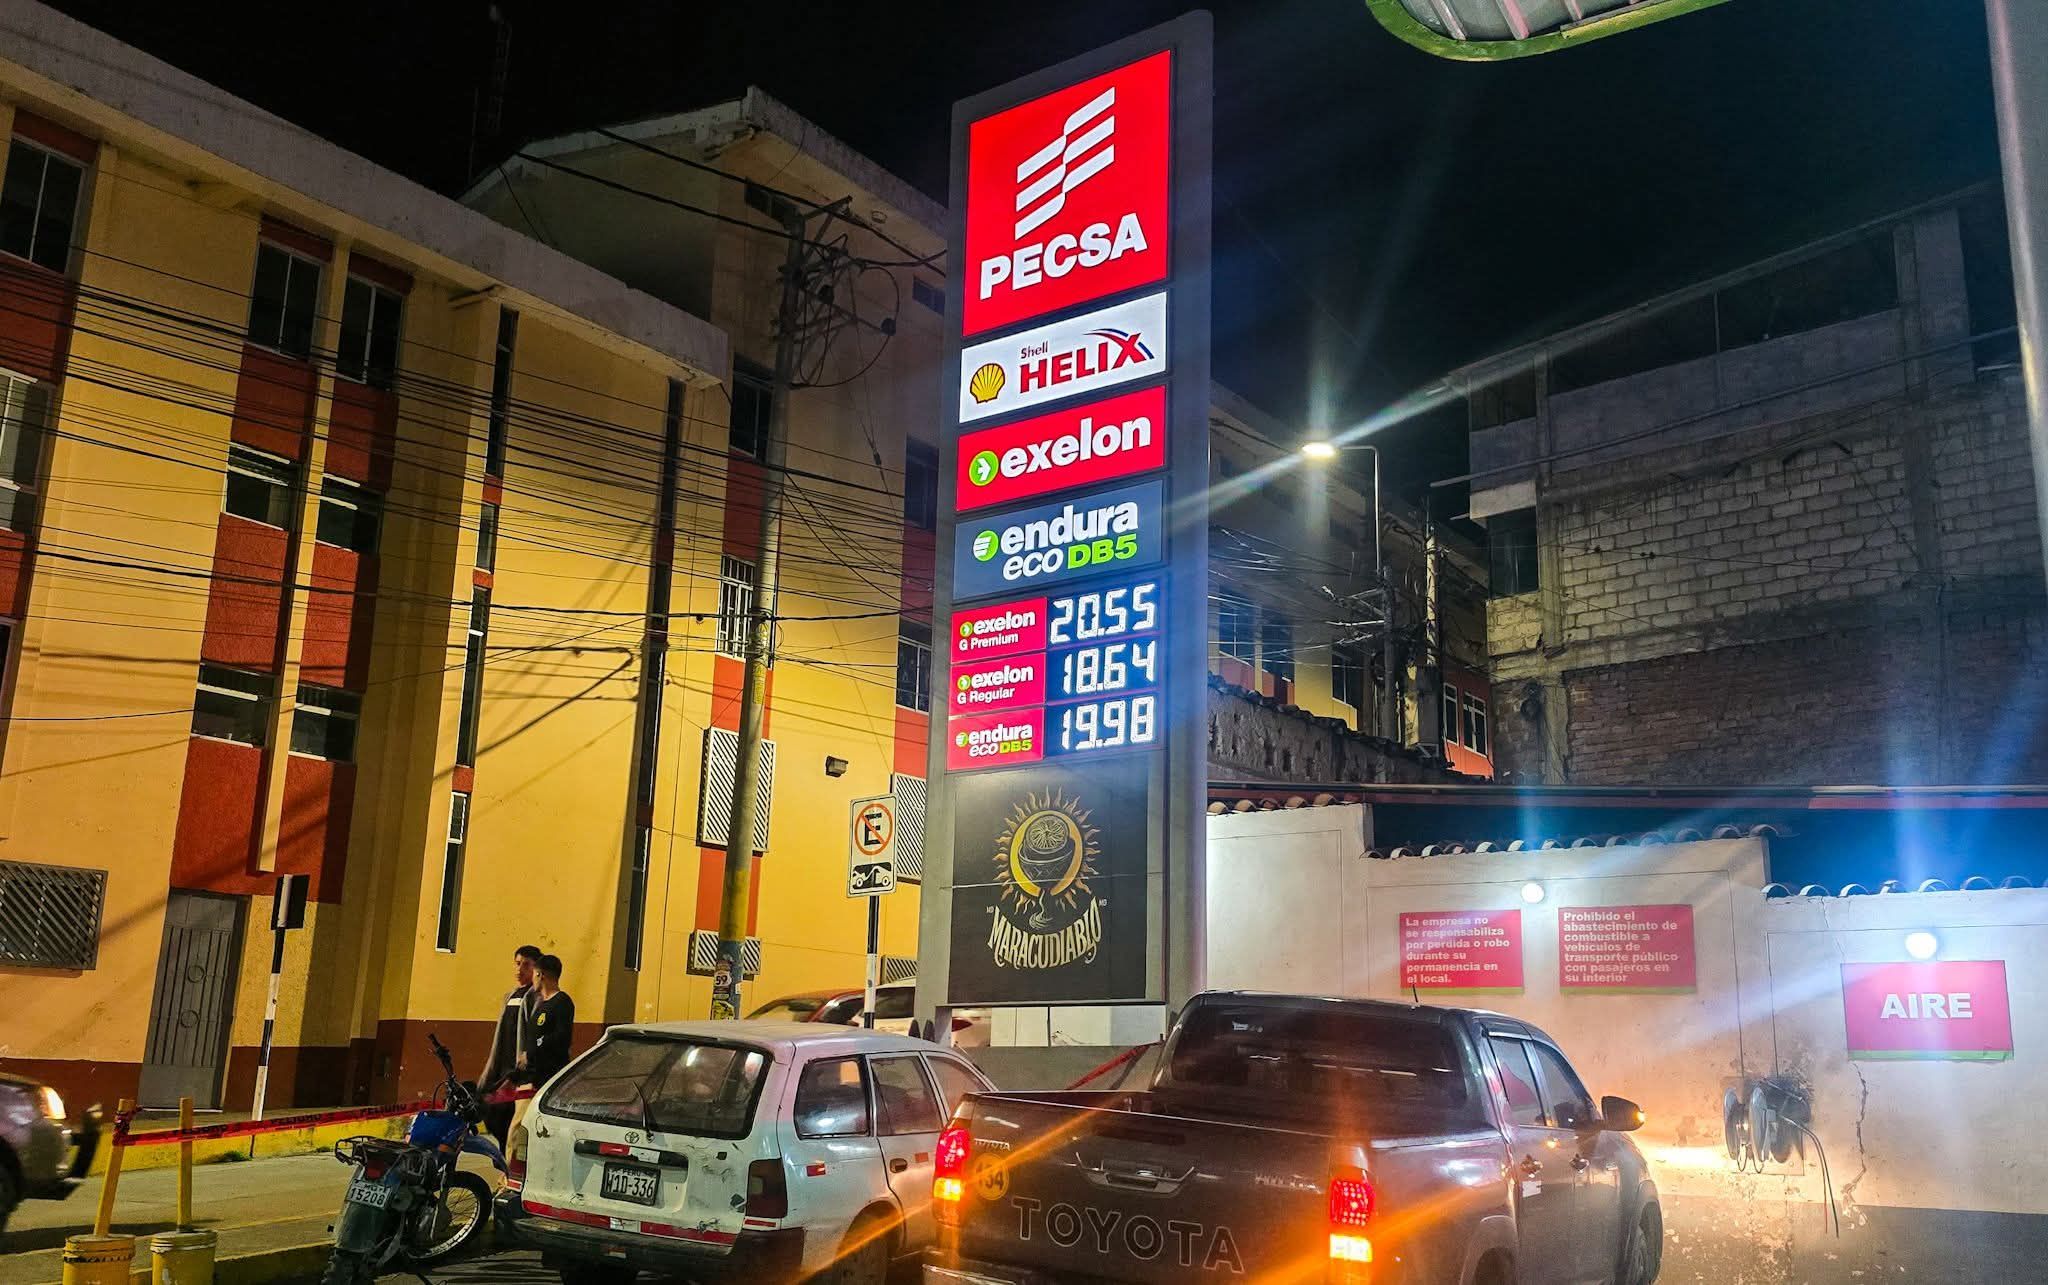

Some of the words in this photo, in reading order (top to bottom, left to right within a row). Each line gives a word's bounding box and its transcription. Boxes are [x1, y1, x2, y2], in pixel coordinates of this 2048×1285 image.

[979, 212, 1148, 301] PECSA
[1020, 341, 1048, 360] Shell
[1019, 331, 1147, 394] HELIX
[1000, 416, 1151, 478] exelon
[1000, 501, 1138, 555] endura
[1067, 533, 1138, 569] DB5
[973, 611, 1036, 635] exelon
[1050, 583, 1156, 645] 20.55
[958, 639, 968, 651] G
[970, 633, 1019, 650] Premium
[971, 665, 1034, 689] exelon
[1062, 640, 1156, 695] 18.64
[957, 692, 967, 705] G
[969, 687, 1015, 704] Regular
[1061, 695, 1155, 750] 19.98
[968, 724, 1033, 745] endura
[864, 812, 884, 846] E
[1405, 917, 1419, 926] La
[1422, 917, 1471, 927] empresa
[1474, 916, 1488, 925] no
[1563, 911, 1620, 922] Prohibido
[1623, 910, 1636, 921] el
[987, 896, 1102, 970] MARACUDIABLO
[1406, 930, 1418, 938] se
[1422, 927, 1504, 938] responsabiliza
[1563, 921, 1659, 932] abastecimiento
[1661, 920, 1678, 930] de
[1406, 941, 1423, 951] por
[1473, 940, 1481, 948] o
[1484, 938, 1510, 948] robo
[1564, 931, 1639, 942] combustible
[1642, 933, 1650, 941] a
[1625, 941, 1641, 951] de
[1406, 951, 1449, 961] durante
[1453, 952, 1467, 960] su
[1564, 952, 1629, 963] transporte
[1407, 961, 1480, 973] permanencia
[1484, 963, 1498, 971] en
[1565, 964, 1587, 972] con
[1590, 963, 1651, 974] pasajeros
[1654, 963, 1670, 972] en
[1407, 974, 1417, 983] el
[1420, 973, 1452, 983] local.
[1565, 974, 1579, 982] su
[1583, 972, 1628, 982] interior
[1880, 992, 1973, 1019] AIRE
[1010, 1196, 1245, 1274] TOYOTA
